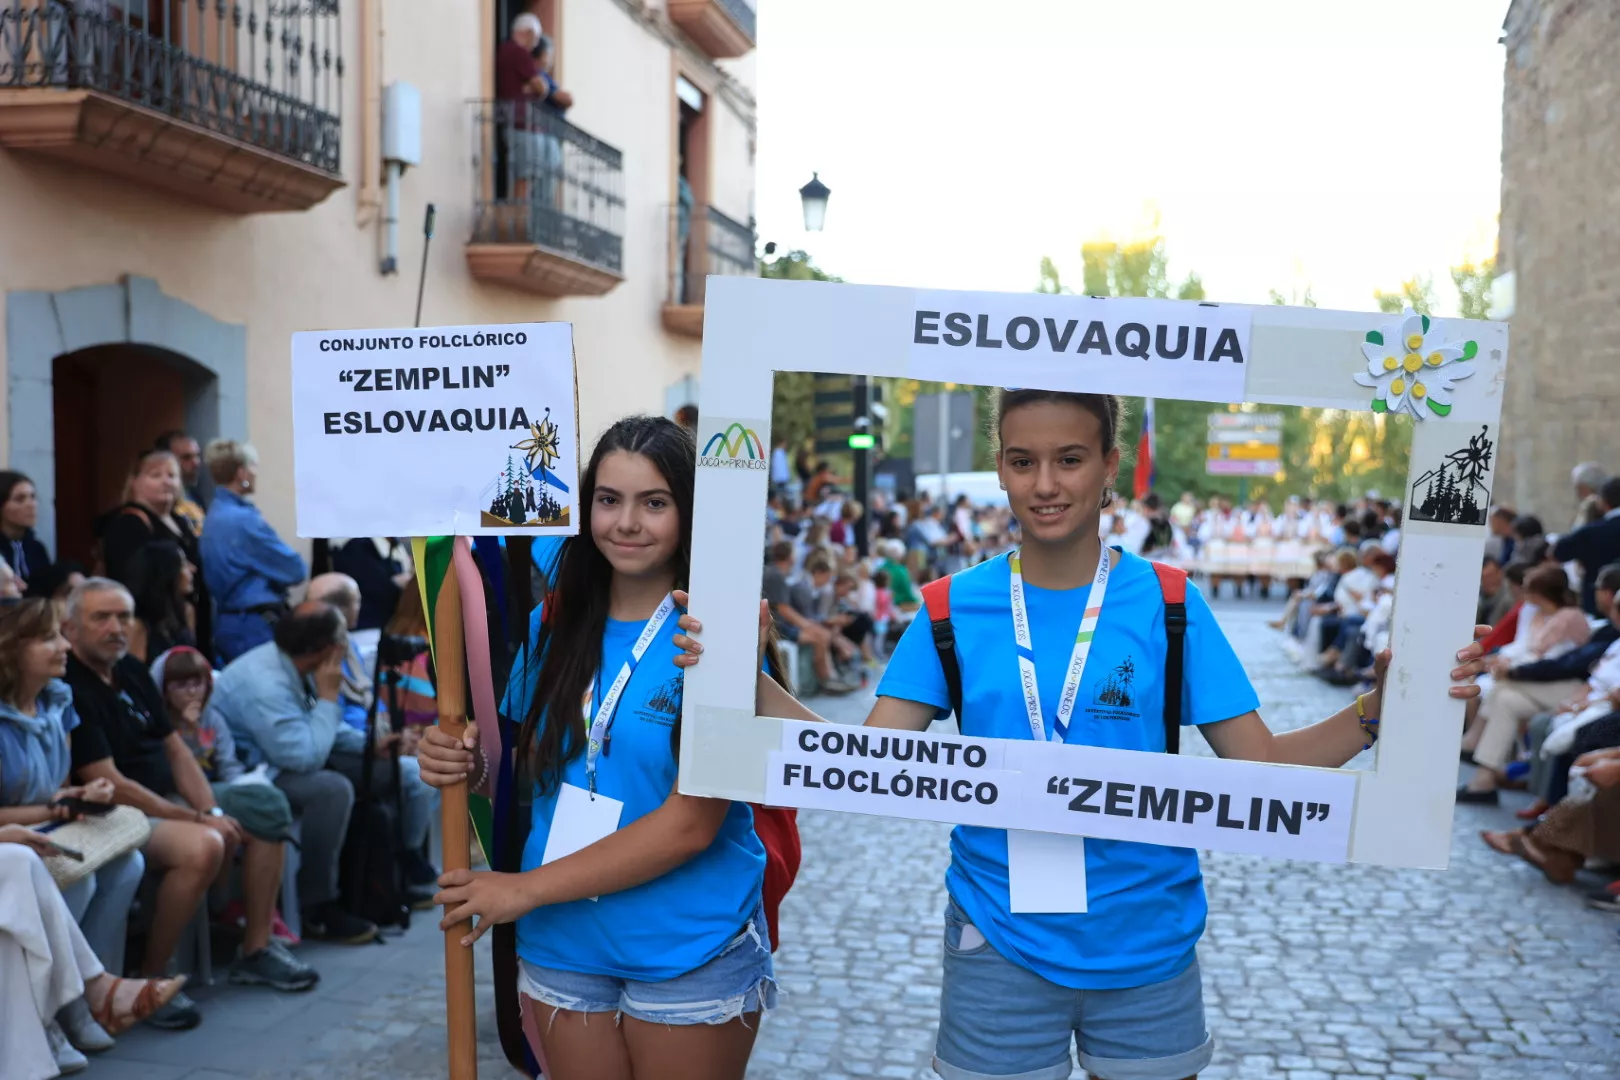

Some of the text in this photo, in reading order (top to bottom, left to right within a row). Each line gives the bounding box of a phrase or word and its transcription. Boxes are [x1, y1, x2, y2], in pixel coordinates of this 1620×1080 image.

[319, 331, 527, 352] CONJUNTO FOLCLÓRICO
[913, 310, 1244, 363] ESLOVAQUIA
[338, 364, 510, 392] “ZEMPLIN”
[323, 407, 531, 435] ESLOVAQUIA
[799, 729, 987, 767] CONJUNTO
[783, 763, 998, 805] FLOCLÓRICO
[1046, 775, 1330, 835] “ZEMPLIN”
